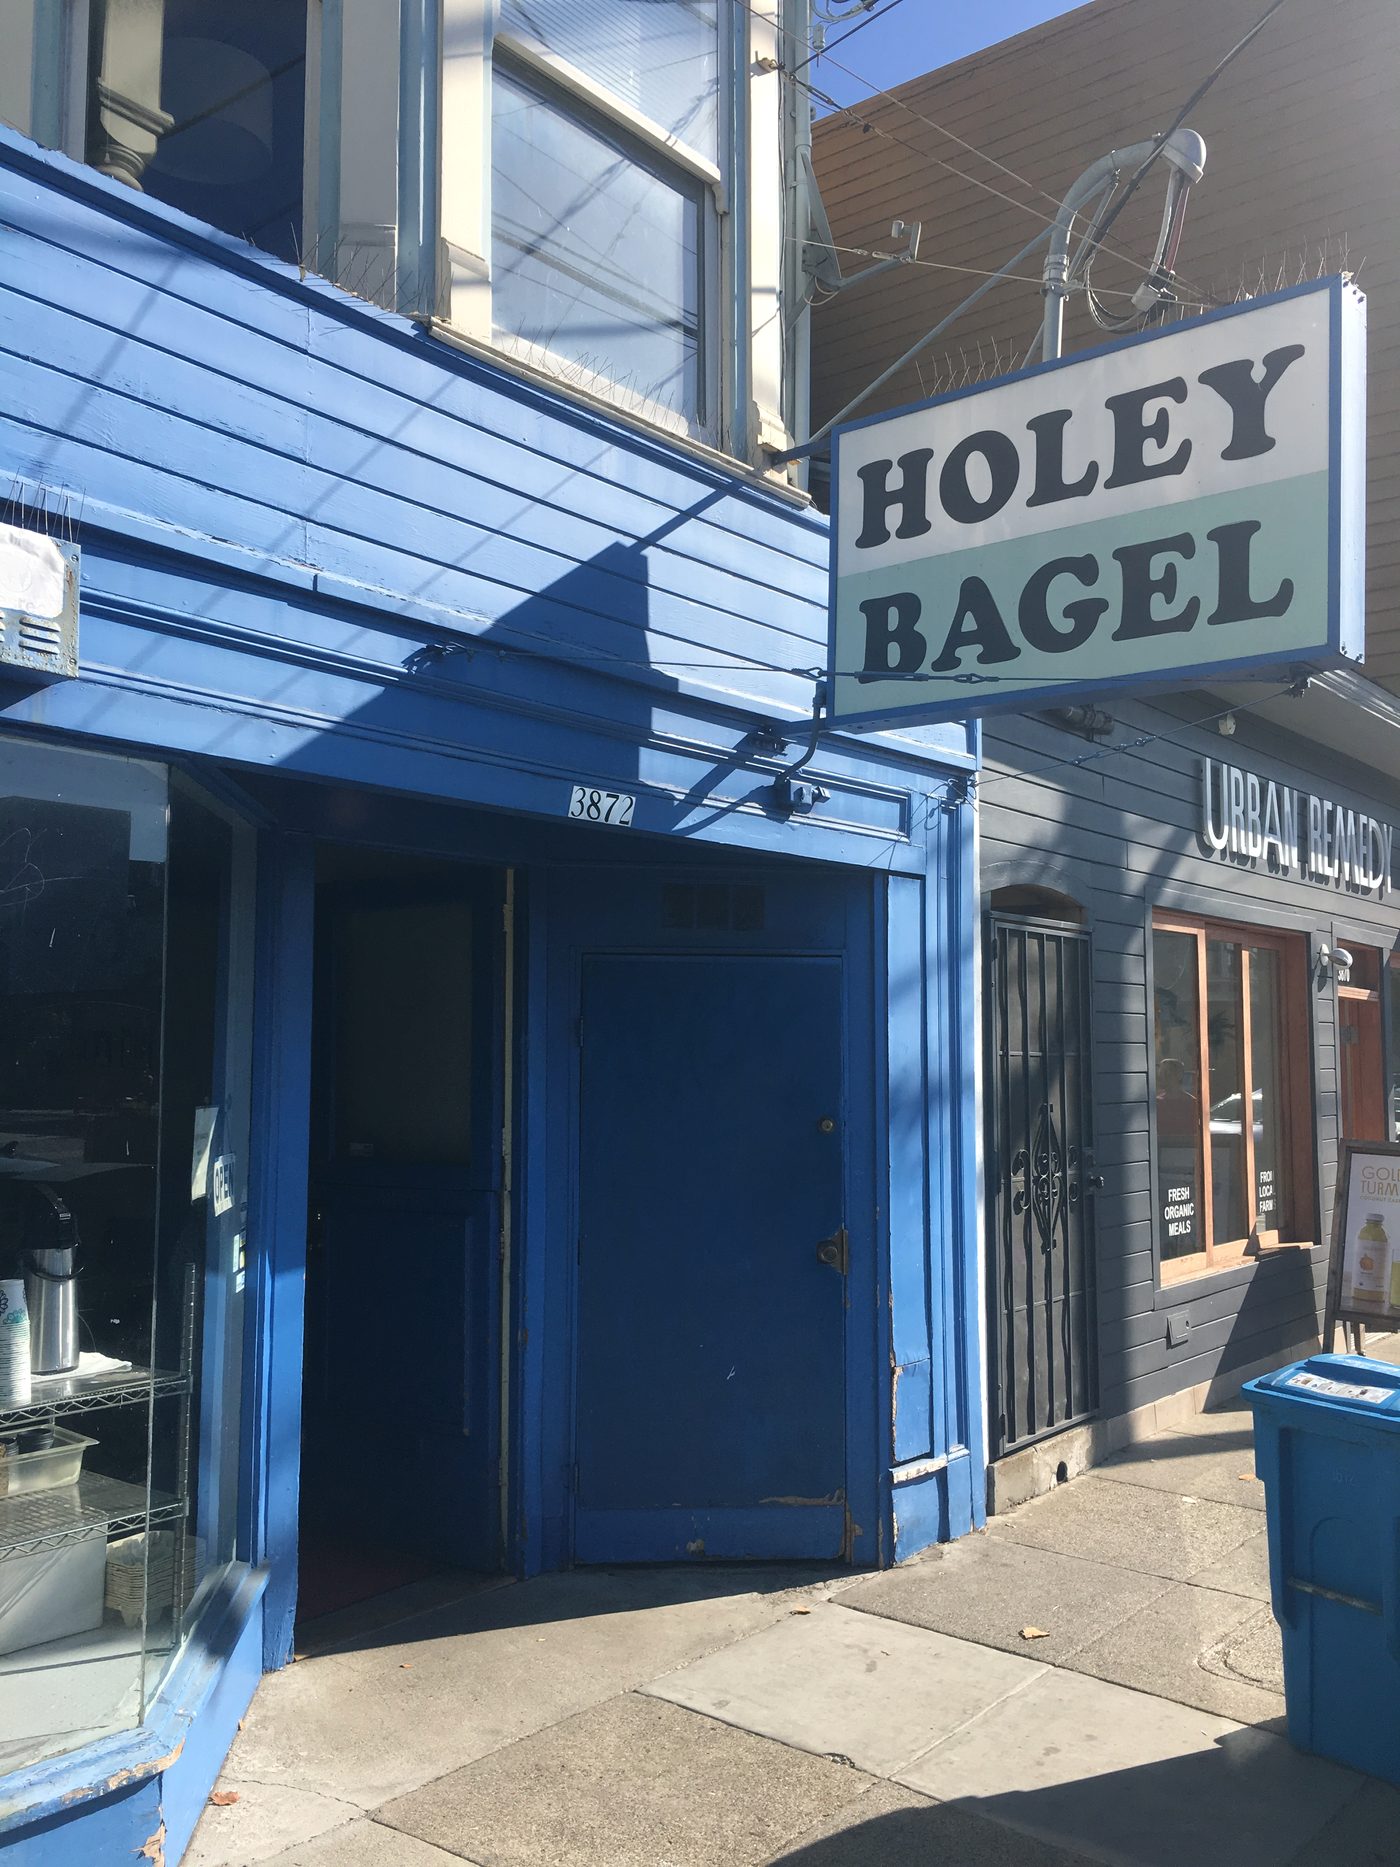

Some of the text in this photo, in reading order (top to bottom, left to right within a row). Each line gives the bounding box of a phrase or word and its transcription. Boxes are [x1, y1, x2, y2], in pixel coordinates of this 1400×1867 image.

[855, 343, 1305, 549] HOLEY
[859, 520, 1294, 684] BAGEL
[570, 787, 634, 826] 3872
[1203, 757, 1393, 894] URBAN REMEDY
[1164, 1203, 1195, 1220] ORGANIC
[1168, 1187, 1190, 1203] FRESH
[1168, 1220, 1191, 1237] MEALS
